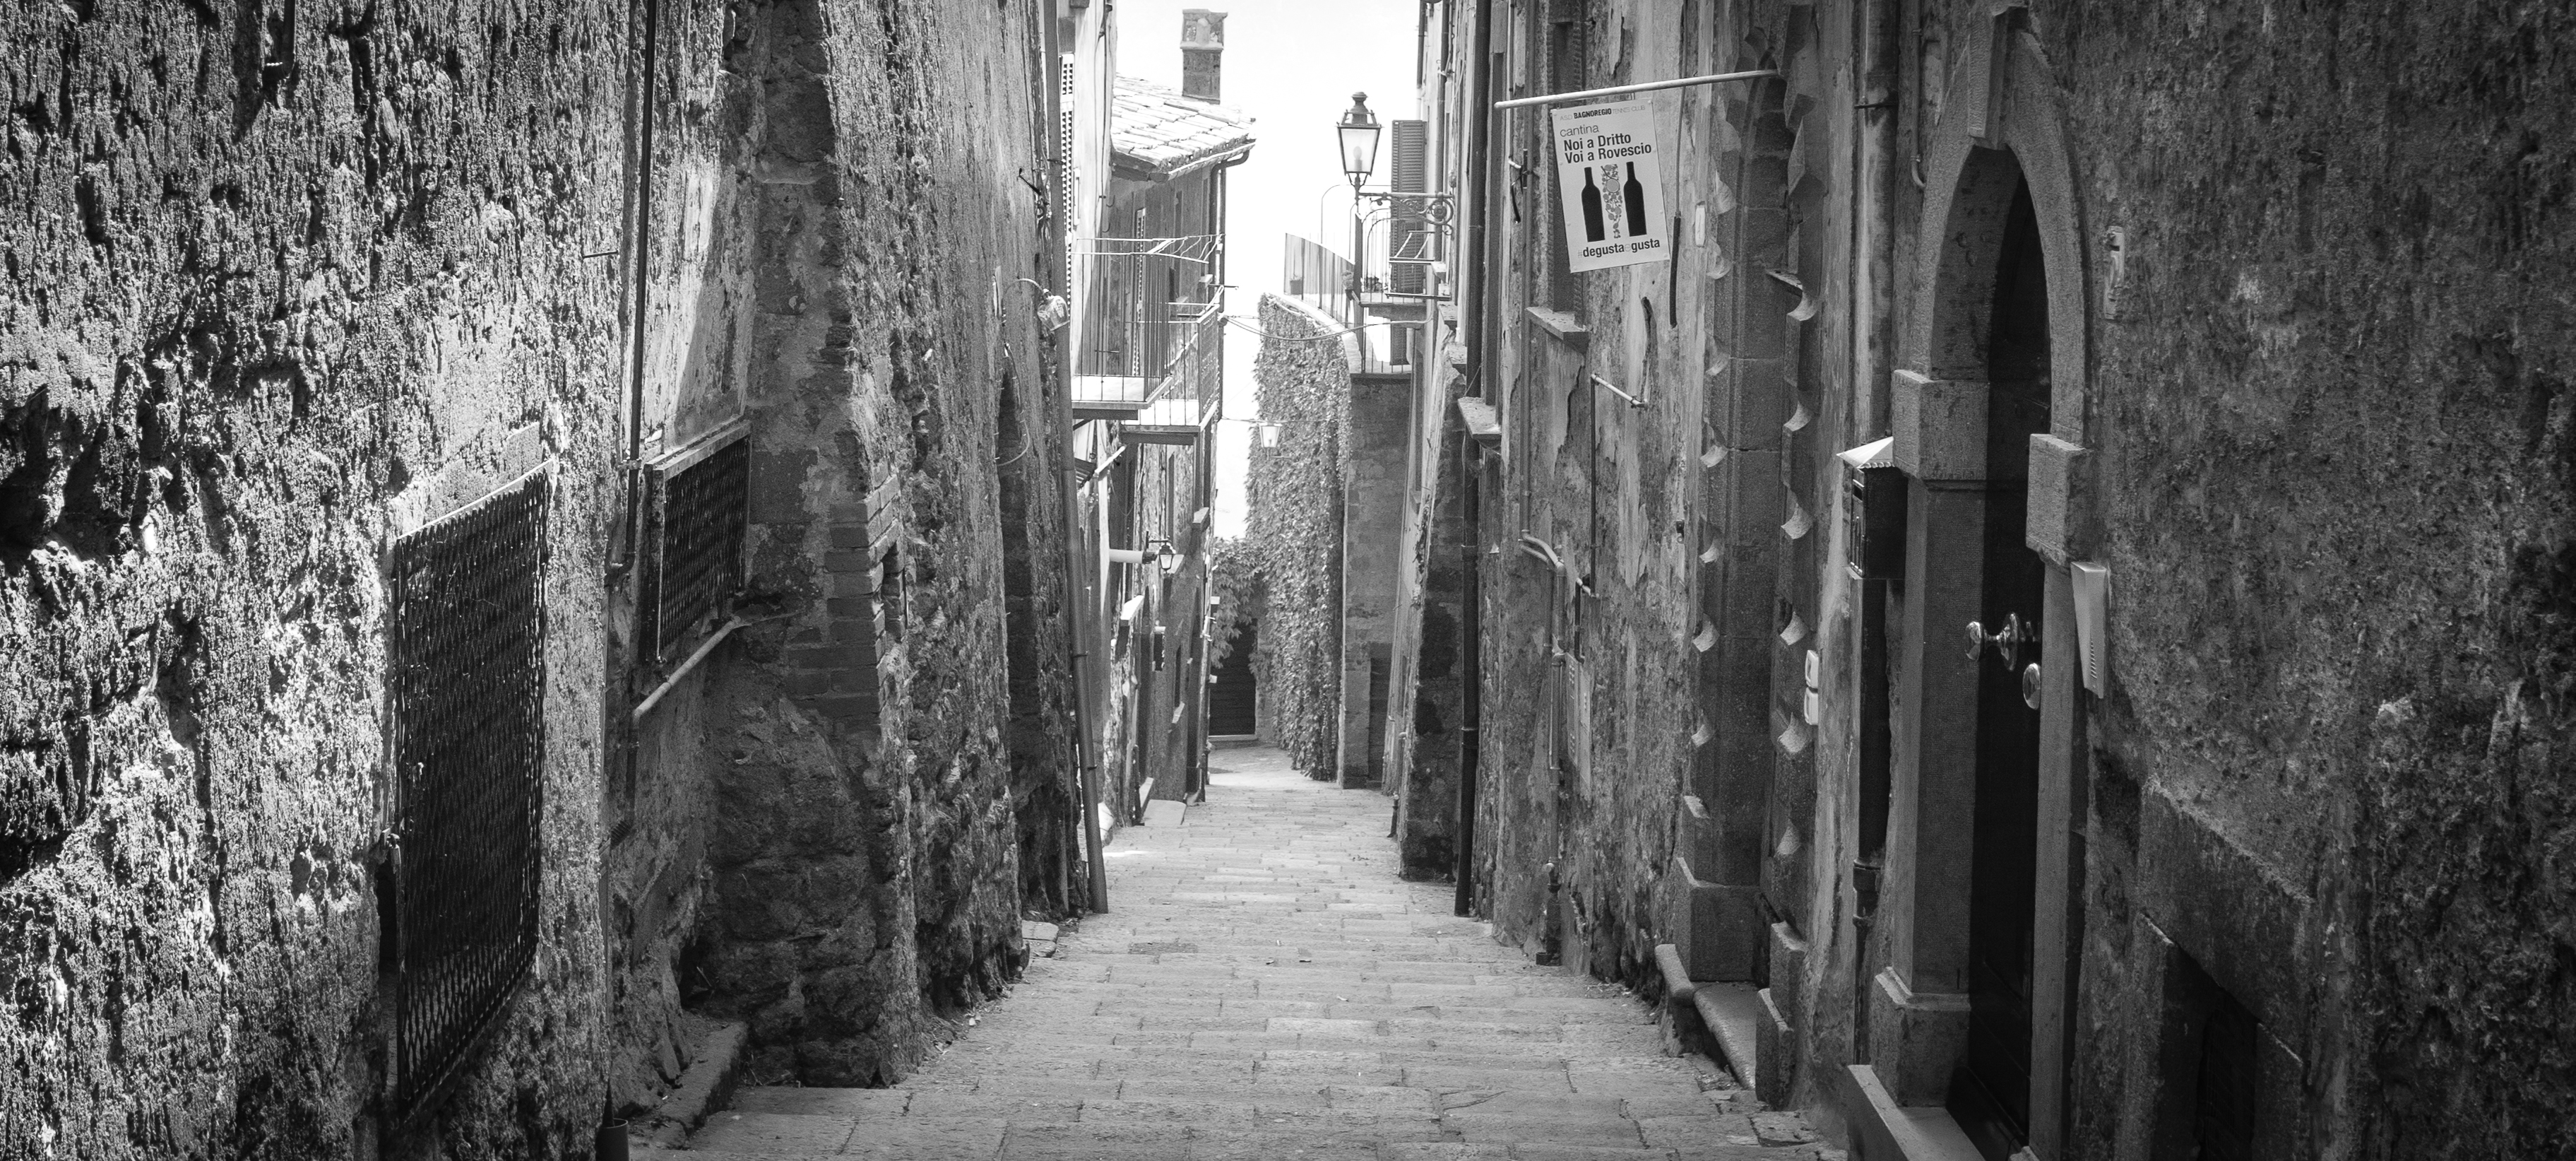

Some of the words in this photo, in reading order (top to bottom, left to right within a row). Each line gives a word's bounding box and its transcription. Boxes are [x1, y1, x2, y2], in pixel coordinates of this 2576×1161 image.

[1574, 108, 1612, 119] BAGNOREGIO
[1560, 124, 1599, 137] cantina
[1564, 138, 1584, 151] Noi
[1587, 139, 1594, 148] a
[1598, 133, 1631, 147] Dritto
[1565, 151, 1584, 164] Voi
[1587, 151, 1595, 161] a
[1598, 142, 1651, 160] Rovescio
